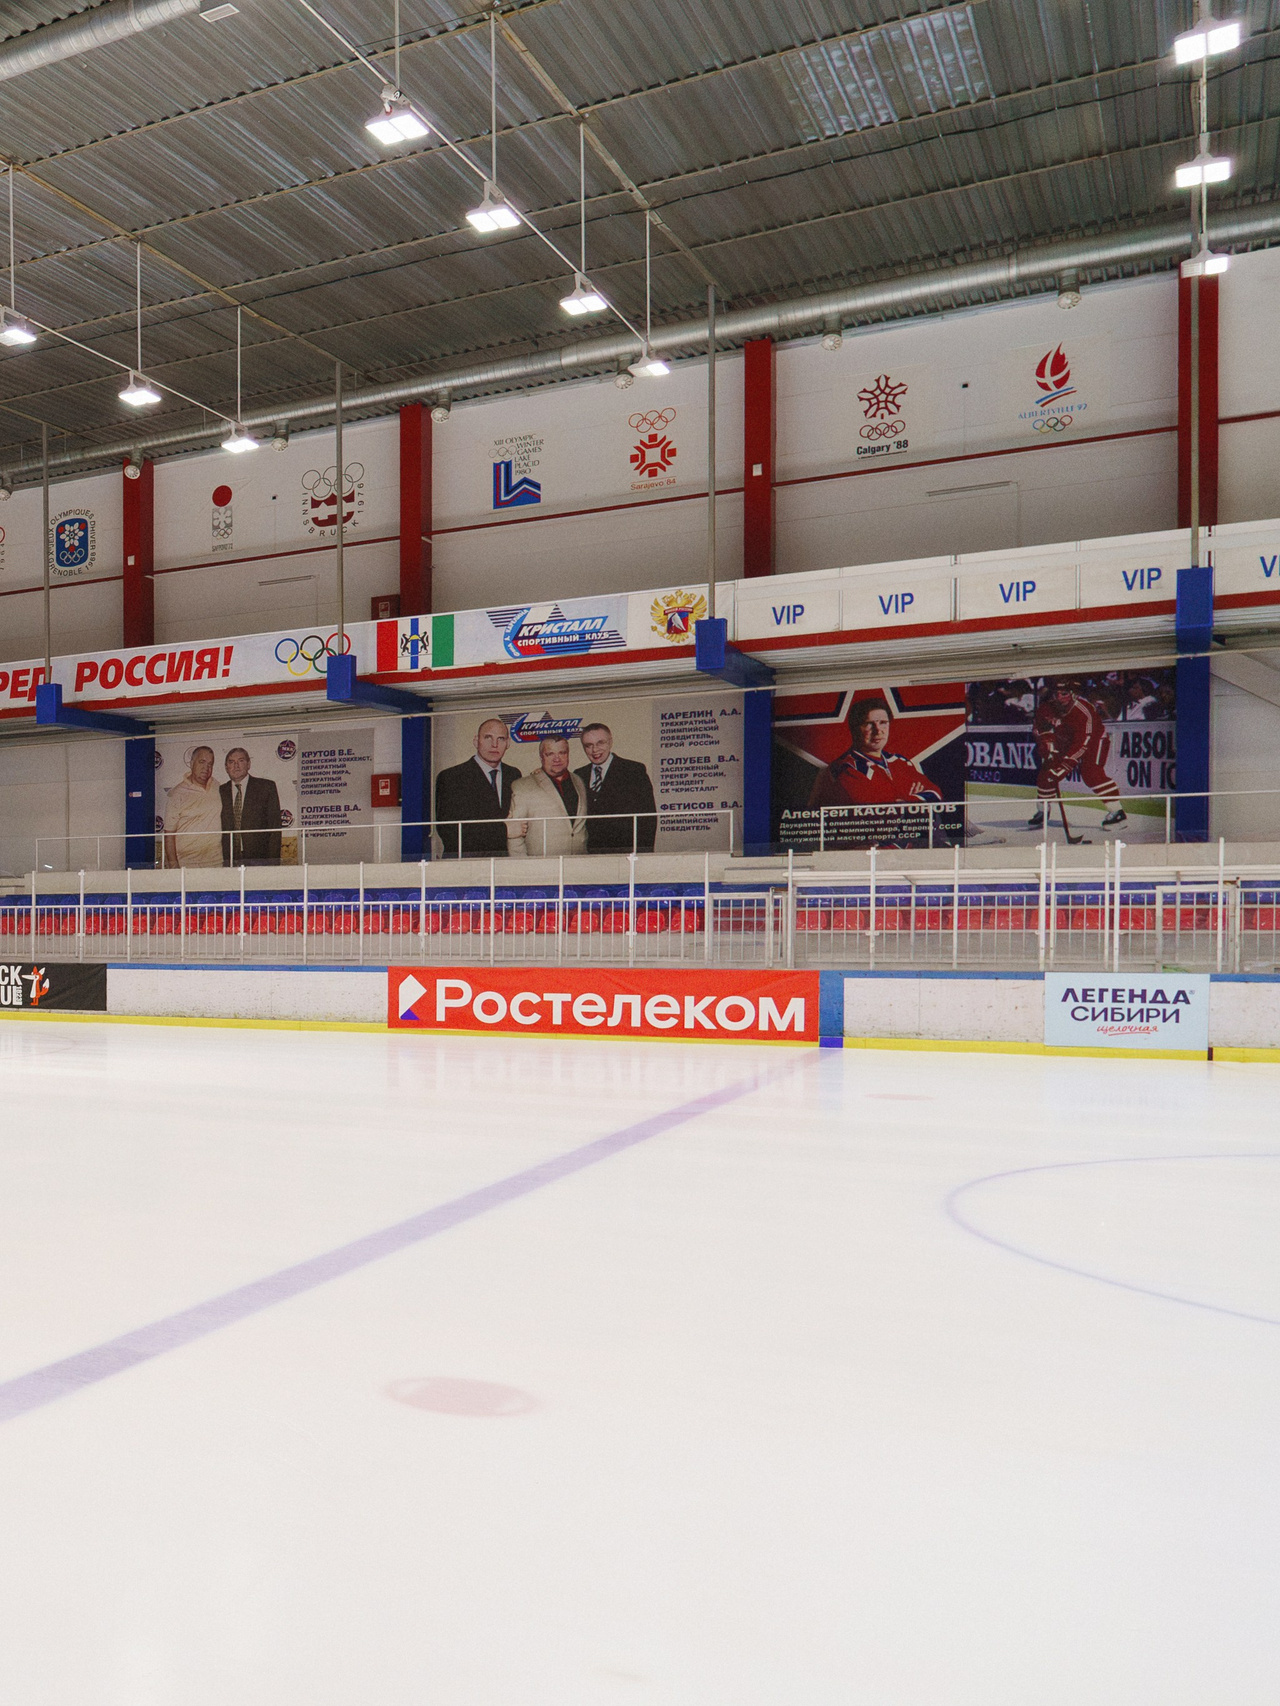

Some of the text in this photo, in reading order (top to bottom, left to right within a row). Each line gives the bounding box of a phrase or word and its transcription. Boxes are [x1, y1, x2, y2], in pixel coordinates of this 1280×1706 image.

[505, 433, 536, 445] OLYMPIC
[516, 439, 544, 448] WINTER
[516, 447, 542, 455] GAMES
[856, 444, 891, 455] Calgary
[514, 454, 531, 462] LAKE
[514, 460, 540, 469] PLACID
[357, 482, 365, 513] 1976
[1122, 567, 1162, 592] VIP
[999, 580, 1036, 603] VIP
[878, 592, 915, 616] VIP
[772, 604, 805, 626] VIP
[518, 618, 604, 637] КРИСТАЛЛ
[517, 633, 580, 647] СПОРТИВНЫЙ
[585, 631, 610, 641] КЛУБ
[74, 645, 234, 692] РОССИЯ!
[661, 708, 741, 721] КАРЕЛИН А.А.
[521, 719, 579, 730] КРИСТАЛЛ
[660, 718, 716, 727] ТРЕХКРАТНЫЙ
[520, 728, 563, 736] СПОРТИВНЫЙ
[660, 724, 719, 734] ОЛИМПИЙСКИЙ
[660, 740, 685, 748] ГЕРОЙ
[1120, 731, 1176, 759] ABSOL
[301, 748, 355, 758] КРУТОВ В.Е.
[660, 754, 740, 765] ГОЛУБЕВ В.А.
[660, 764, 719, 773] ЗАСЛУЖЕННЫЙ
[1127, 760, 1152, 788] ON
[301, 805, 342, 813] ГОЛУБЕВ
[660, 801, 743, 811] ФЕТИСОВ В.А.
[853, 804, 957, 817] КАСАТОНОВ
[660, 817, 719, 825] ОЛИМПИЙСКИЙ
[829, 819, 885, 827] олимпийский
[837, 834, 866, 842] мастер
[1061, 987, 1191, 1005] ЛЕГЕНДА
[436, 978, 805, 1032] Ростелеком
[1070, 1006, 1180, 1024] СИБИРИ
[1096, 1025, 1158, 1034] щелочная
